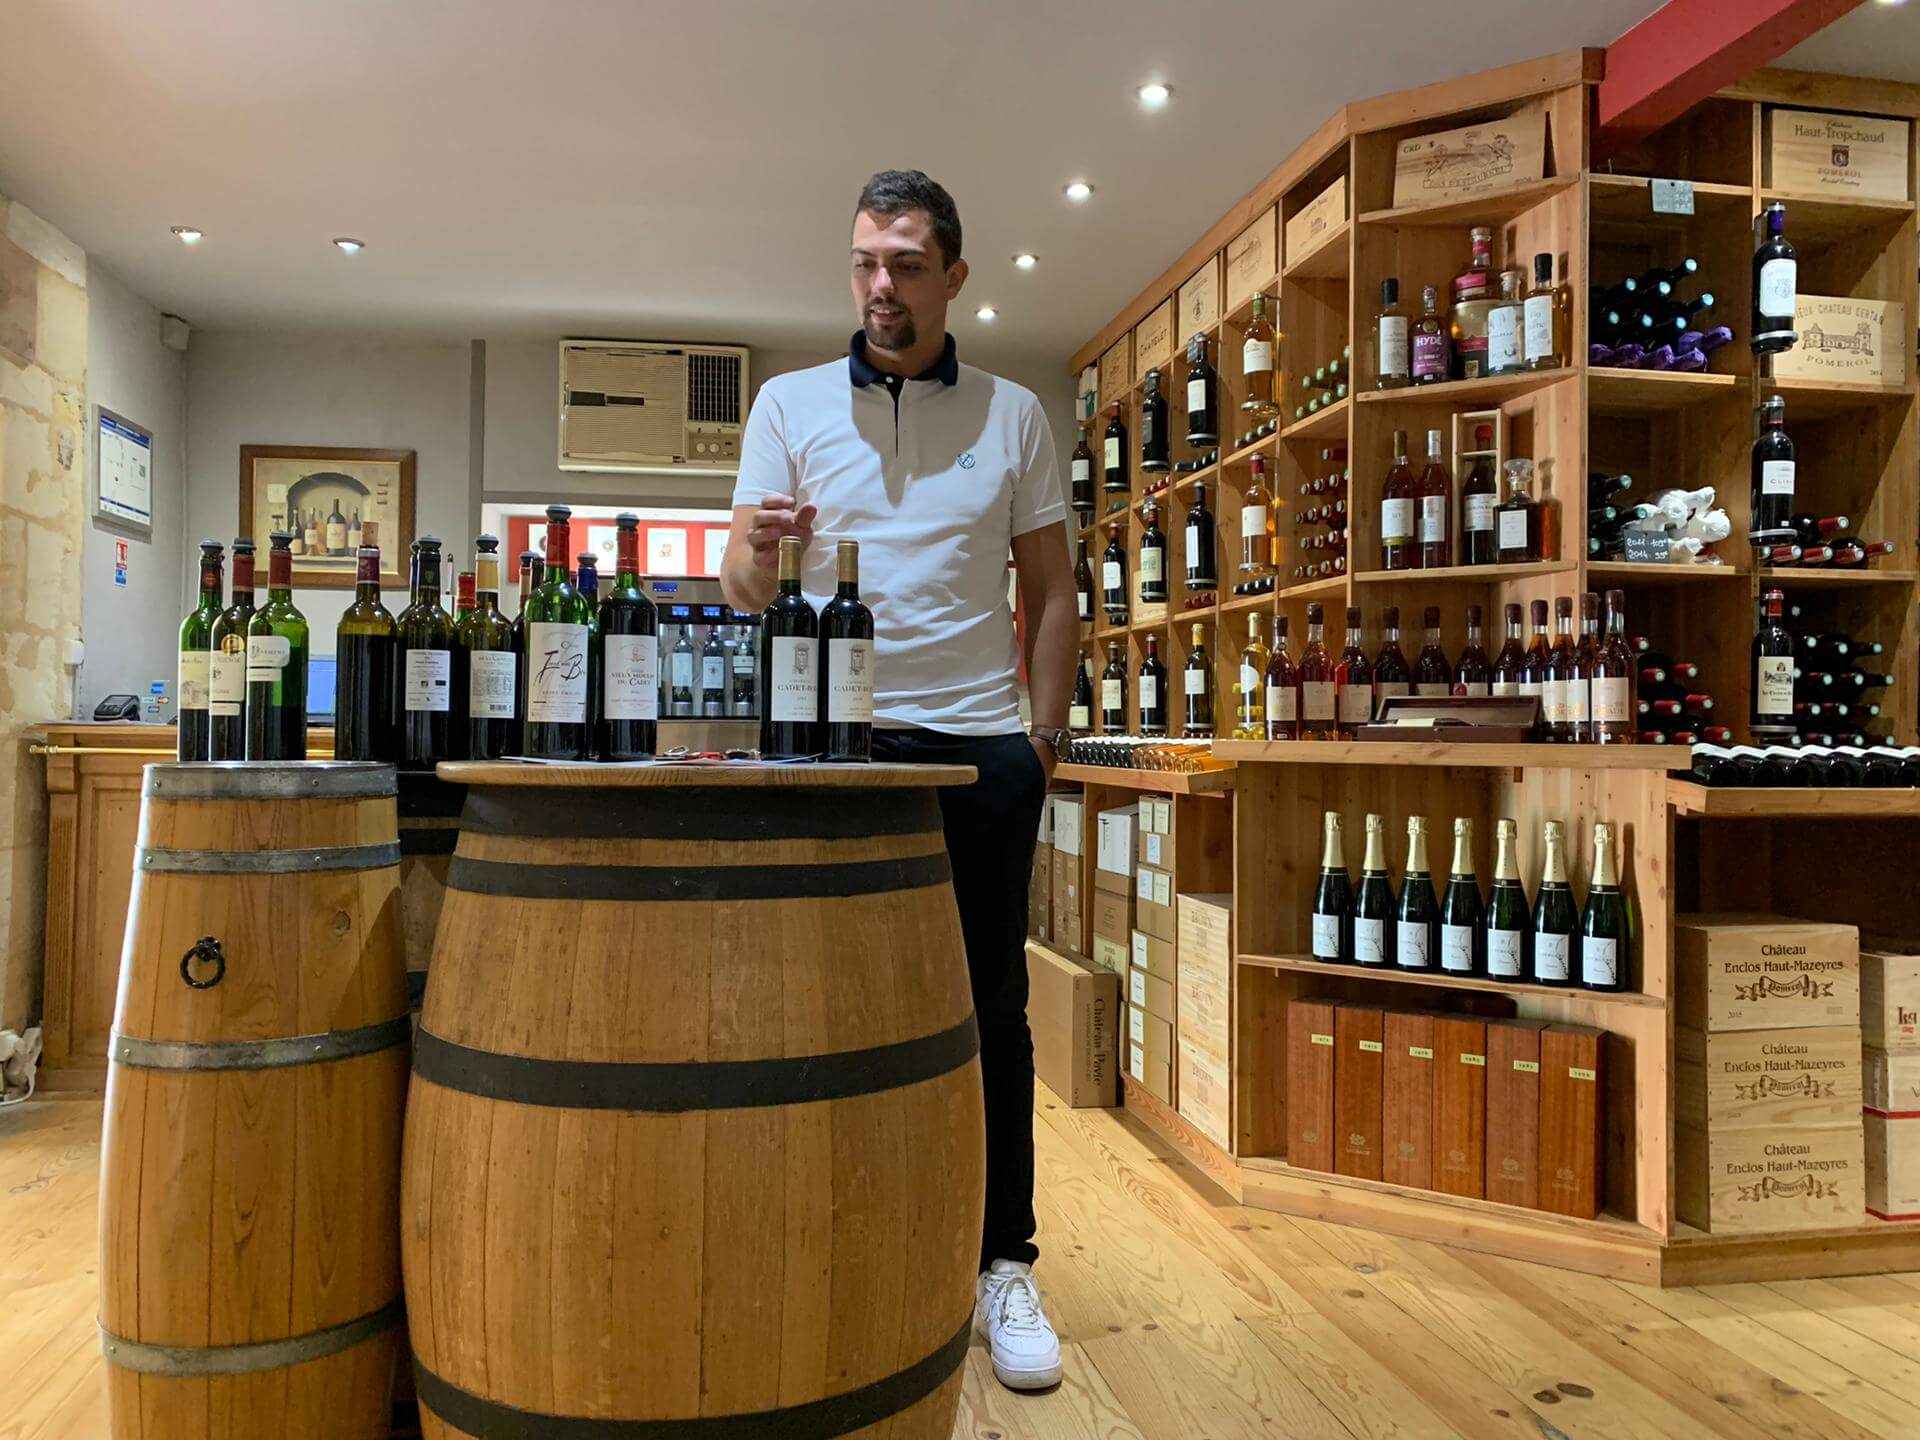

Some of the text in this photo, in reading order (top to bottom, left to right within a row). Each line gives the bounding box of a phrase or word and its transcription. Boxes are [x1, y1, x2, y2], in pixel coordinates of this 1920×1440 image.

[1794, 124, 1885, 144] Haut-Tropchaud
[1817, 167, 1863, 179] POMEROL
[1818, 303, 1852, 315] CHATEAU
[1416, 335, 1443, 347] HYDE
[1806, 353, 1873, 368] POMEROL
[1761, 944, 1806, 956] Château
[1724, 960, 1844, 974] Enclos Haut-Mazeyres
[1094, 998, 1106, 1086] Château Pavie
[1761, 1043, 1808, 1055] Château
[1724, 1059, 1846, 1073] Enclos Haut-Mazeyres
[1764, 1143, 1811, 1156] Château
[1726, 1159, 1849, 1175] Enclos Haut-Mazeyres
